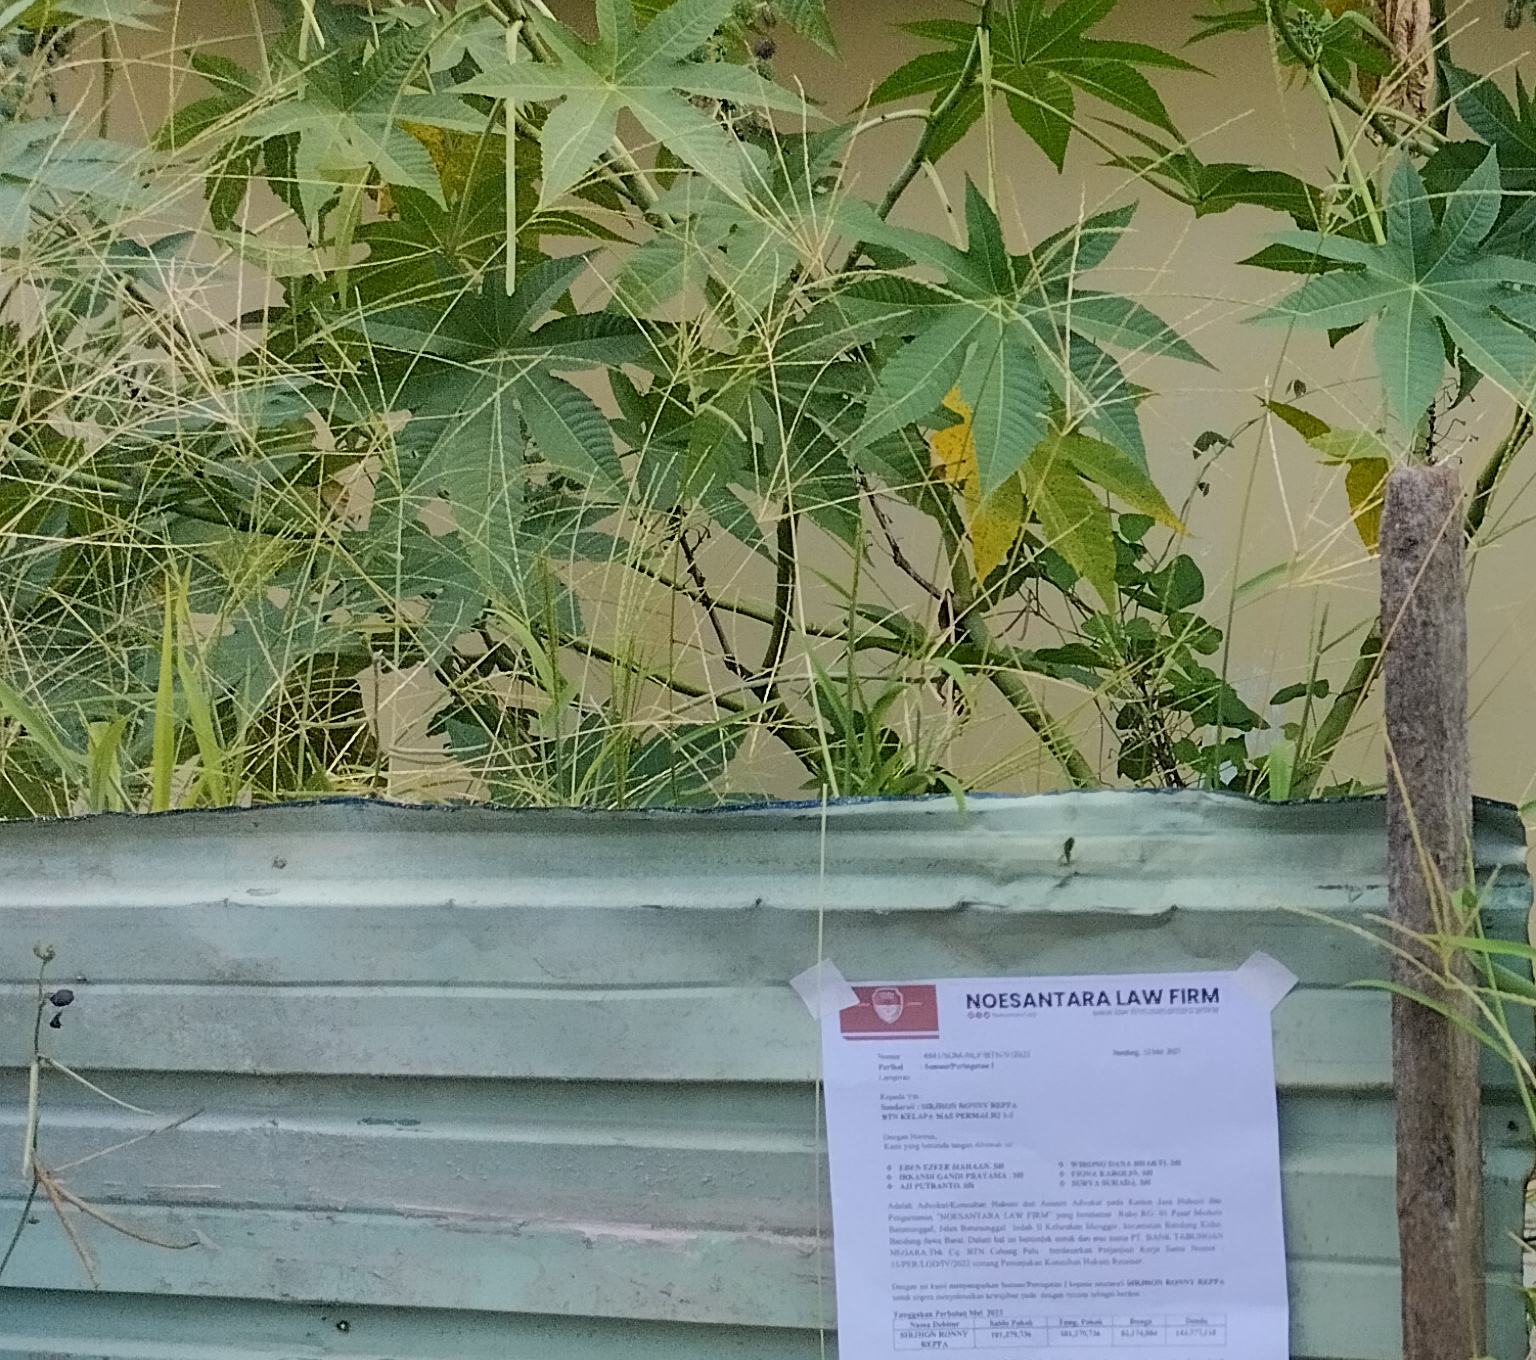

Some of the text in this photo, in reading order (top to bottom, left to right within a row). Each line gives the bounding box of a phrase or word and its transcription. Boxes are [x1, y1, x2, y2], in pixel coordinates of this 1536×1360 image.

[967, 987, 1220, 1009] NOESANTARA LAW FIRM
